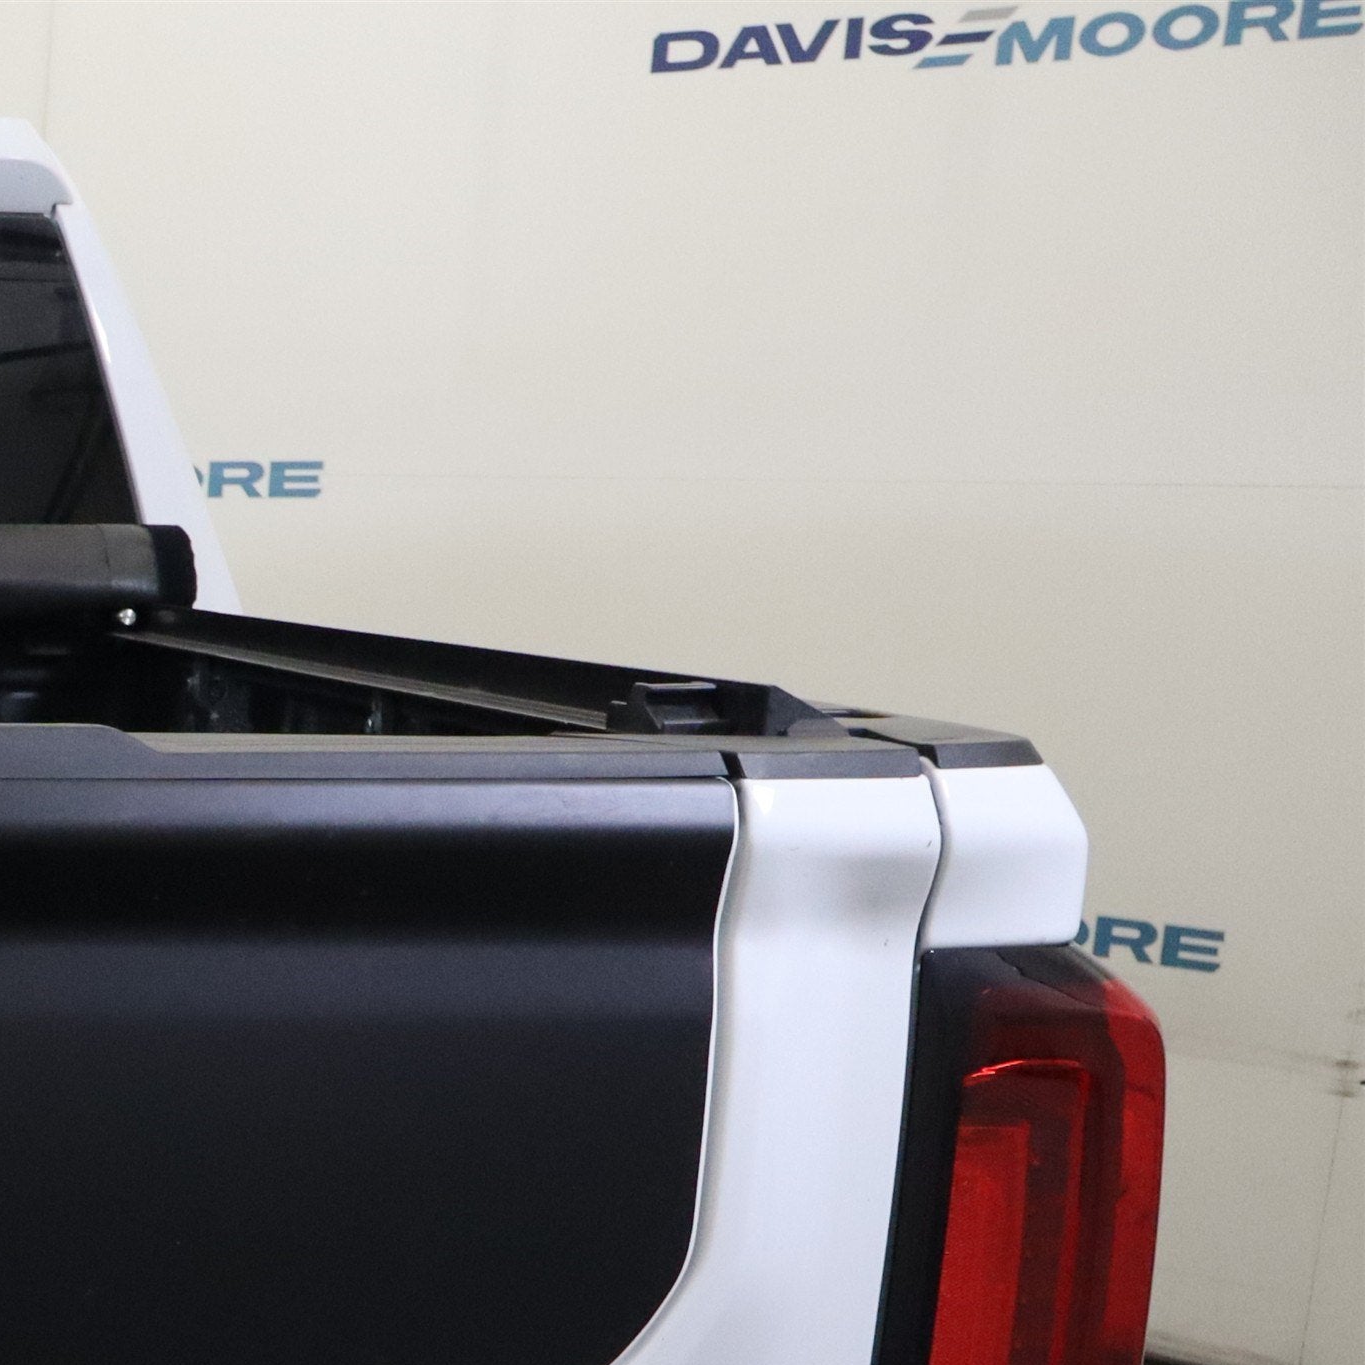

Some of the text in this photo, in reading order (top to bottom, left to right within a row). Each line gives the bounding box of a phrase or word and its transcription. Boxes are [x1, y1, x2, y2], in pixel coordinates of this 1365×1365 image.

[650, 0, 1364, 74] DAVIS MOORE
[193, 461, 324, 498] RE
[1072, 915, 1225, 973] RE
